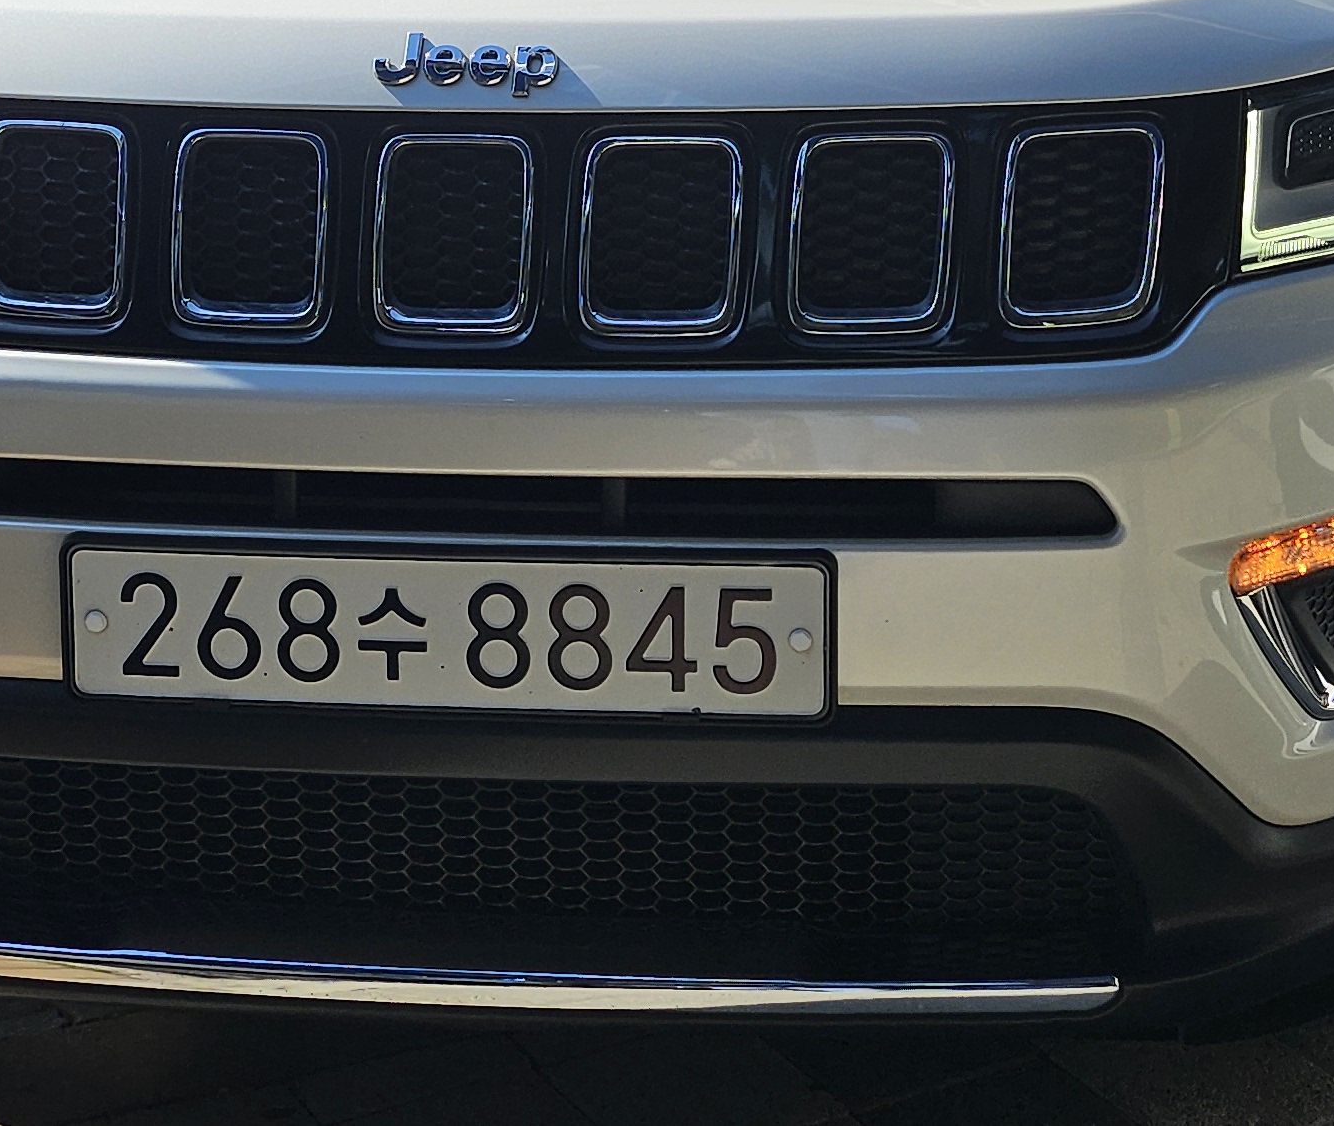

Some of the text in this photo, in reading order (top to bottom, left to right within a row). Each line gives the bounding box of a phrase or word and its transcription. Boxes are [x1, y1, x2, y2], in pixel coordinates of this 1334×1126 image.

[373, 32, 559, 97] Jeep
[119, 572, 778, 694] 268수 8845
